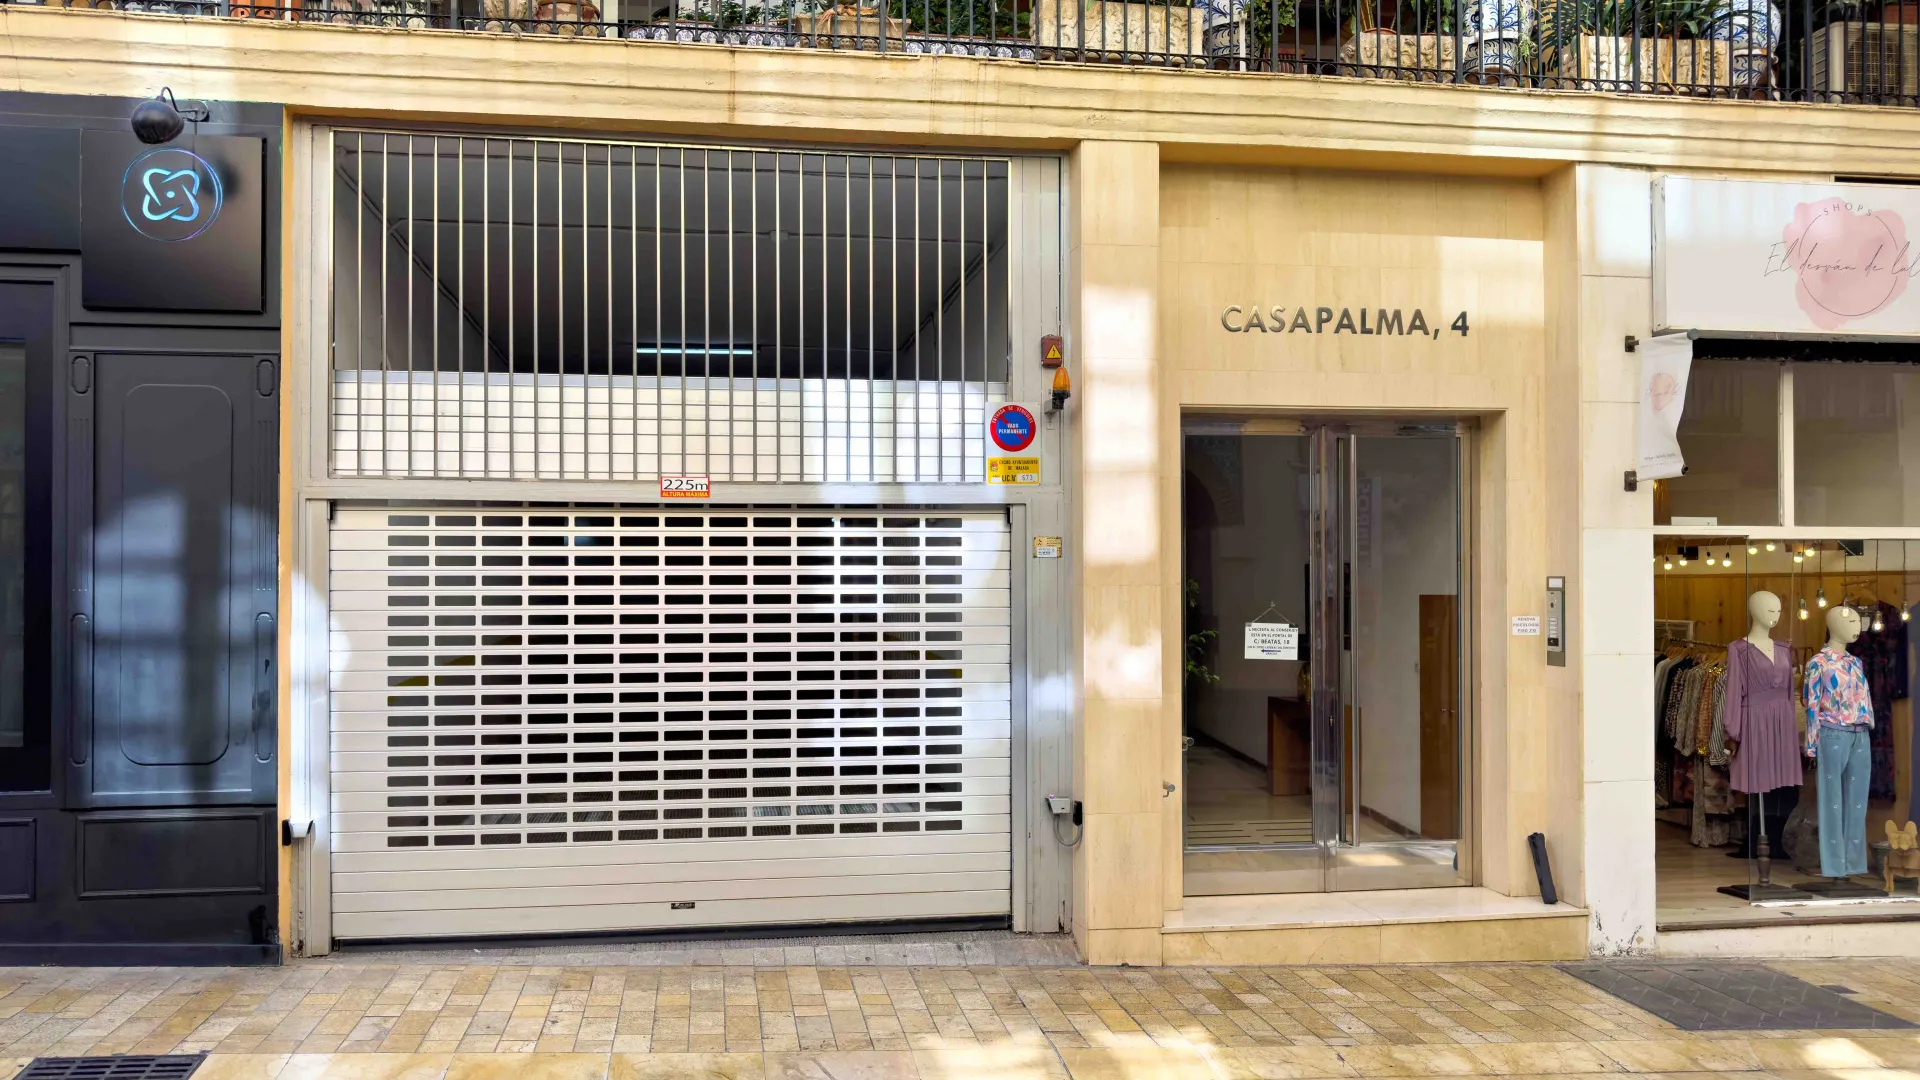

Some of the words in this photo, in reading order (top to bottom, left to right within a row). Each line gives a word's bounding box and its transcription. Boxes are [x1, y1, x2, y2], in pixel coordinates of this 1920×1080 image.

[1823, 202, 1873, 217] SHOPS
[1764, 237, 1799, 277] El
[1864, 244, 1884, 277] de
[1221, 304, 1440, 340] CASAPALMA,
[1450, 311, 1469, 337] 4
[664, 479, 708, 490] 225m
